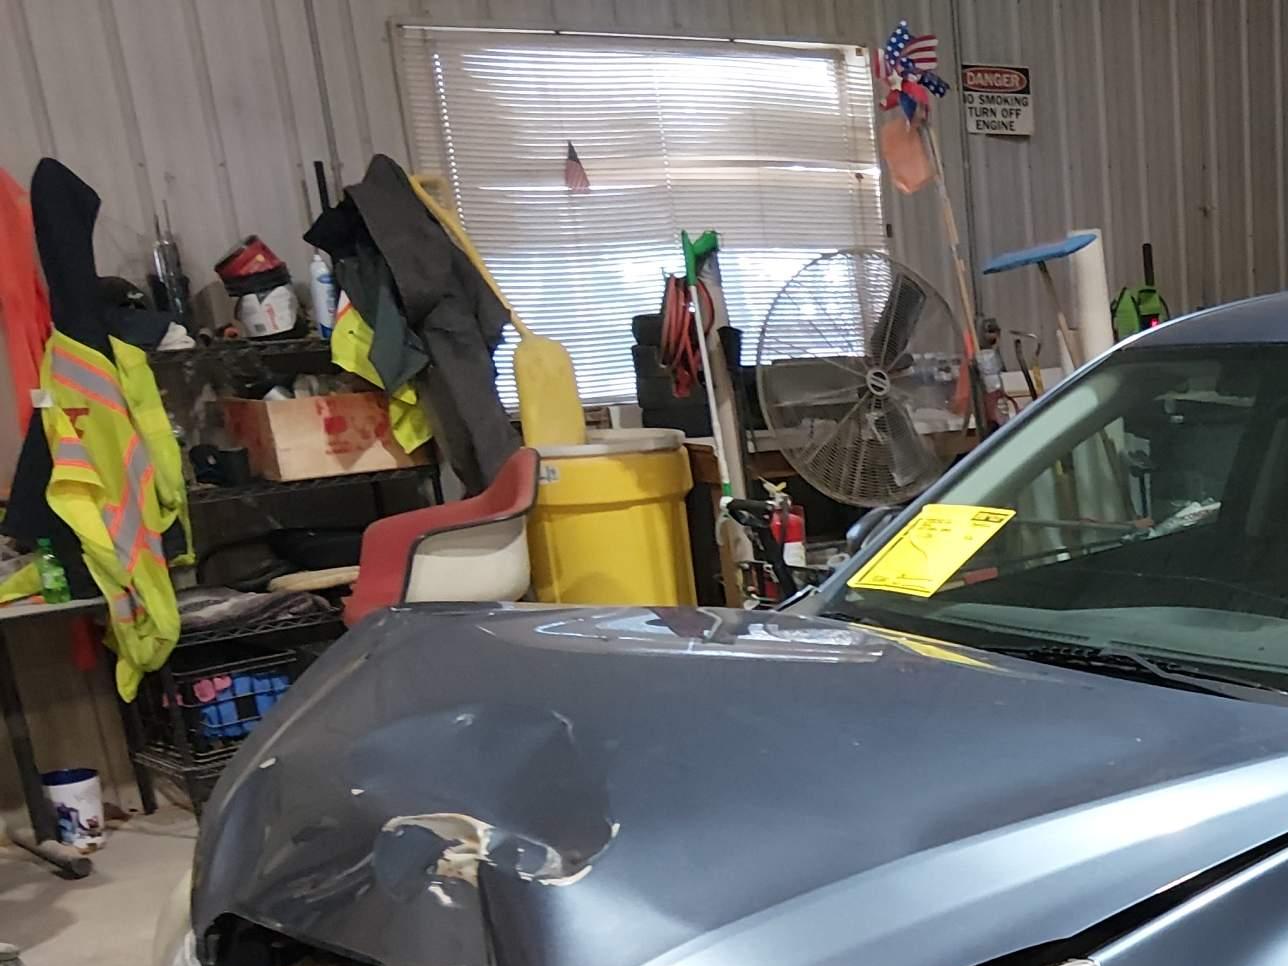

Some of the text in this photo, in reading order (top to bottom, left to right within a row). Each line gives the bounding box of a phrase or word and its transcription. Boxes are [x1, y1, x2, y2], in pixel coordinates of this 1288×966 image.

[966, 72, 1020, 88] DANGER
[978, 94, 1029, 107] SMOKING
[967, 106, 1022, 119] TURN OFF
[975, 119, 1016, 132] ENGINE
